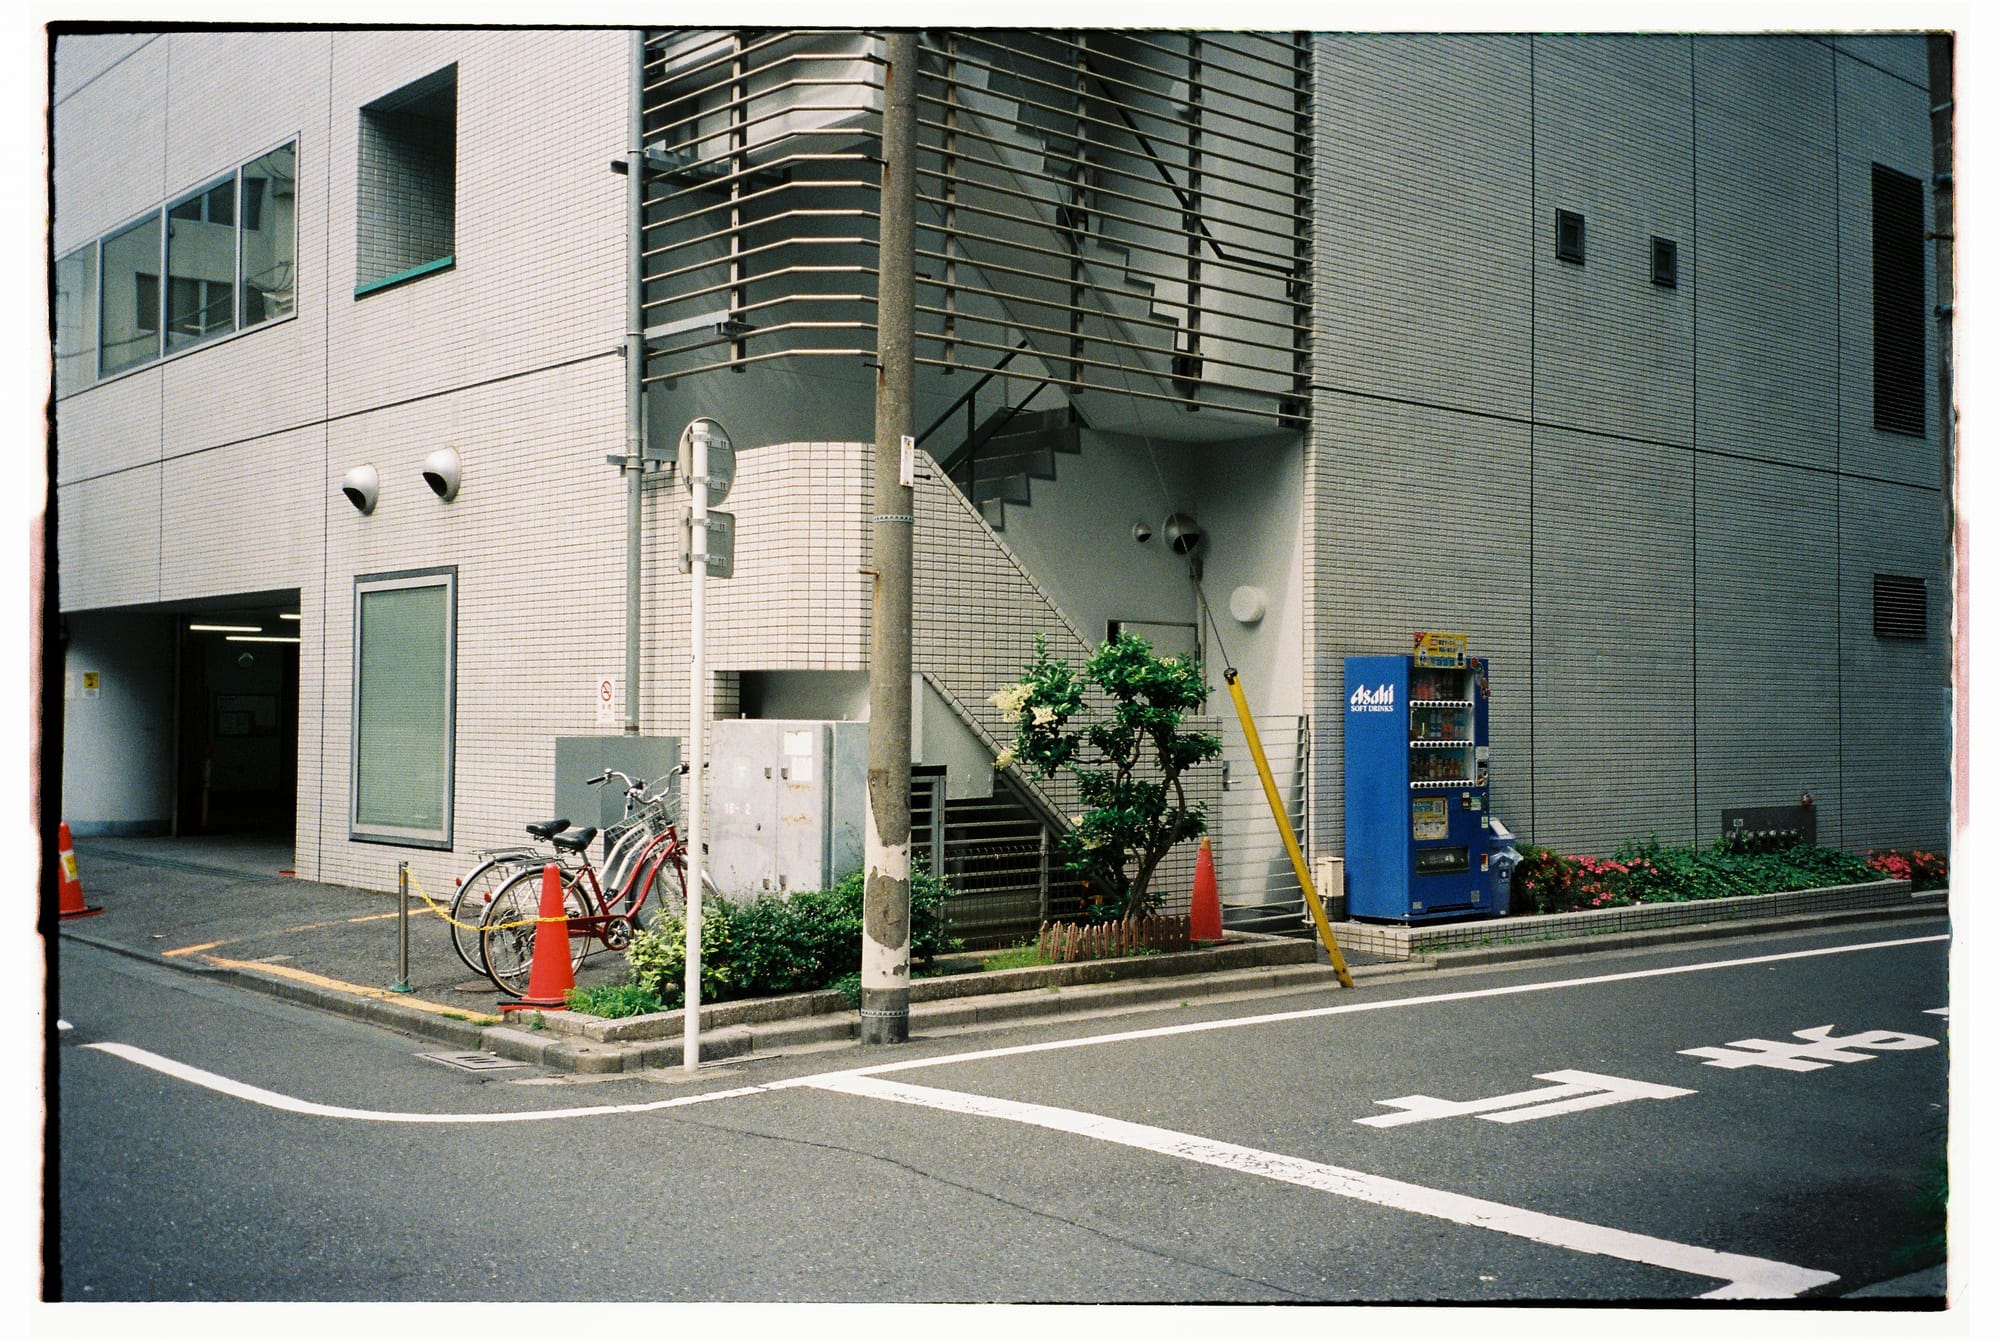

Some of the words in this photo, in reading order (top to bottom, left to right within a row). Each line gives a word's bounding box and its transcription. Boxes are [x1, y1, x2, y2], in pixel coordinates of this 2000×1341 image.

[1351, 684, 1394, 705] Asahi
[1352, 705, 1367, 713] SOFT
[1368, 705, 1394, 713] DRINKS
[1352, 1007, 1949, 1127] 止ま
